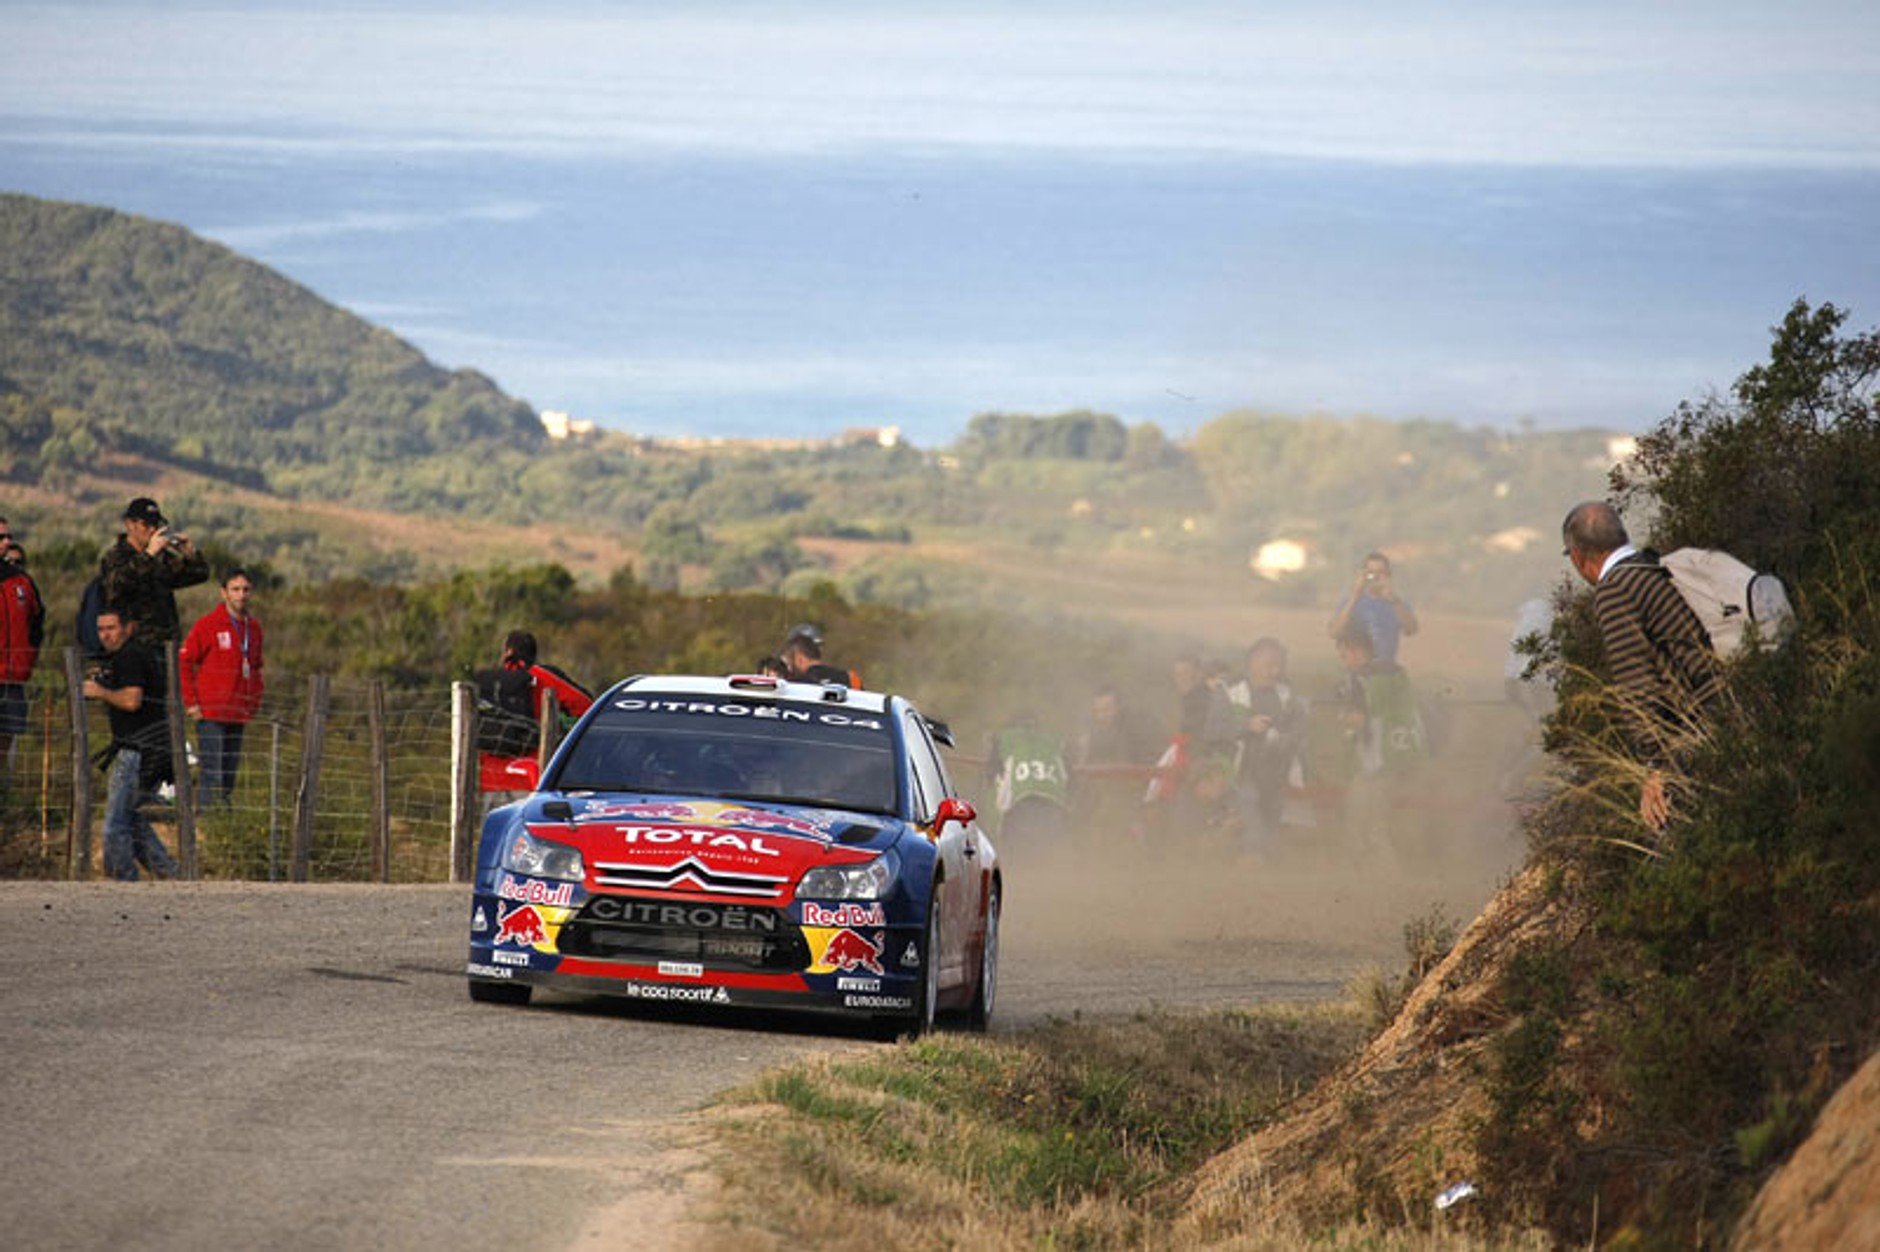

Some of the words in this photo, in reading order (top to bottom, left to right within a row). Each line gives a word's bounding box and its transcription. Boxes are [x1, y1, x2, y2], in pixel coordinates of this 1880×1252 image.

[614, 699, 810, 721] CITROËN
[819, 713, 883, 730] C4
[615, 826, 780, 856] TOTAL
[530, 880, 574, 906] Bull
[591, 899, 776, 930] CITROËN
[802, 901, 849, 927] Red
[849, 904, 887, 927] Bull
[627, 982, 640, 996] le
[641, 986, 668, 999] coq
